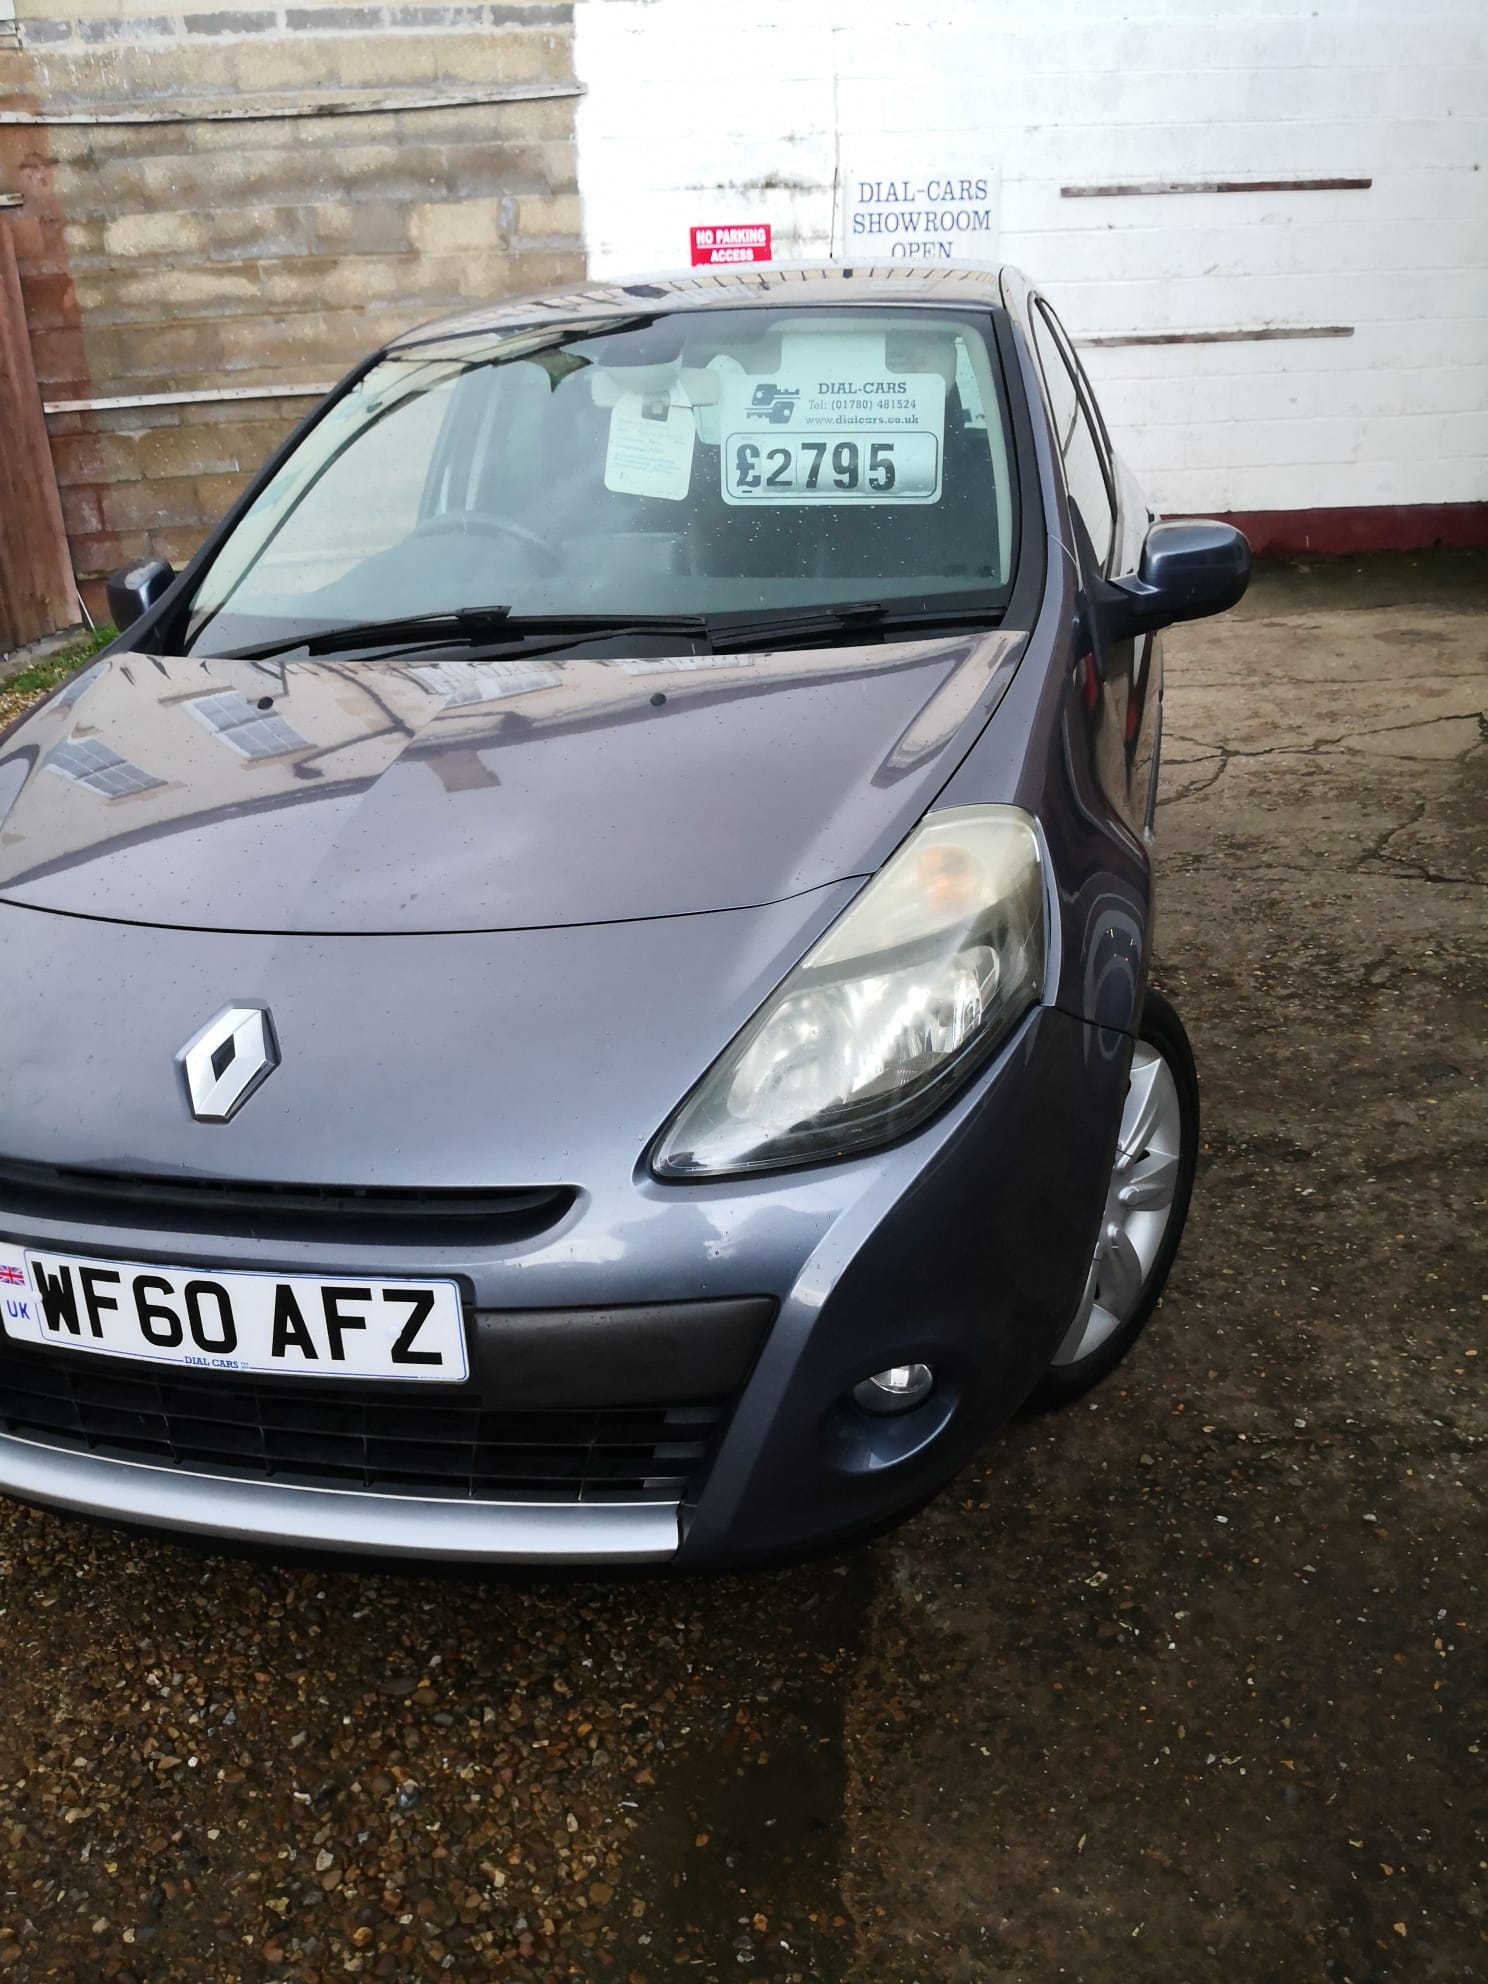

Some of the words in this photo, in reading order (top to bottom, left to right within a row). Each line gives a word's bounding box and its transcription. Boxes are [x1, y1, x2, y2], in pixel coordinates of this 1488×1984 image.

[858, 179, 988, 203] DIAL-CARS
[853, 210, 992, 234] SHOWROOM
[696, 229, 714, 245] NO
[716, 228, 766, 244] PARKING
[710, 248, 755, 263] ACCESS
[818, 382, 907, 394] DIAL-CARS
[809, 400, 828, 410] Tel:
[831, 399, 873, 411] (01780)
[876, 399, 916, 410] 481524
[805, 414, 919, 424] www.dialcars.co.uk
[736, 442, 896, 493] £2795
[6, 1299, 31, 1320] UK
[31, 1261, 238, 1354] WF60
[271, 1284, 443, 1366] AFZ
[184, 1355, 210, 1366] DIAL
[212, 1359, 239, 1369] CARS
